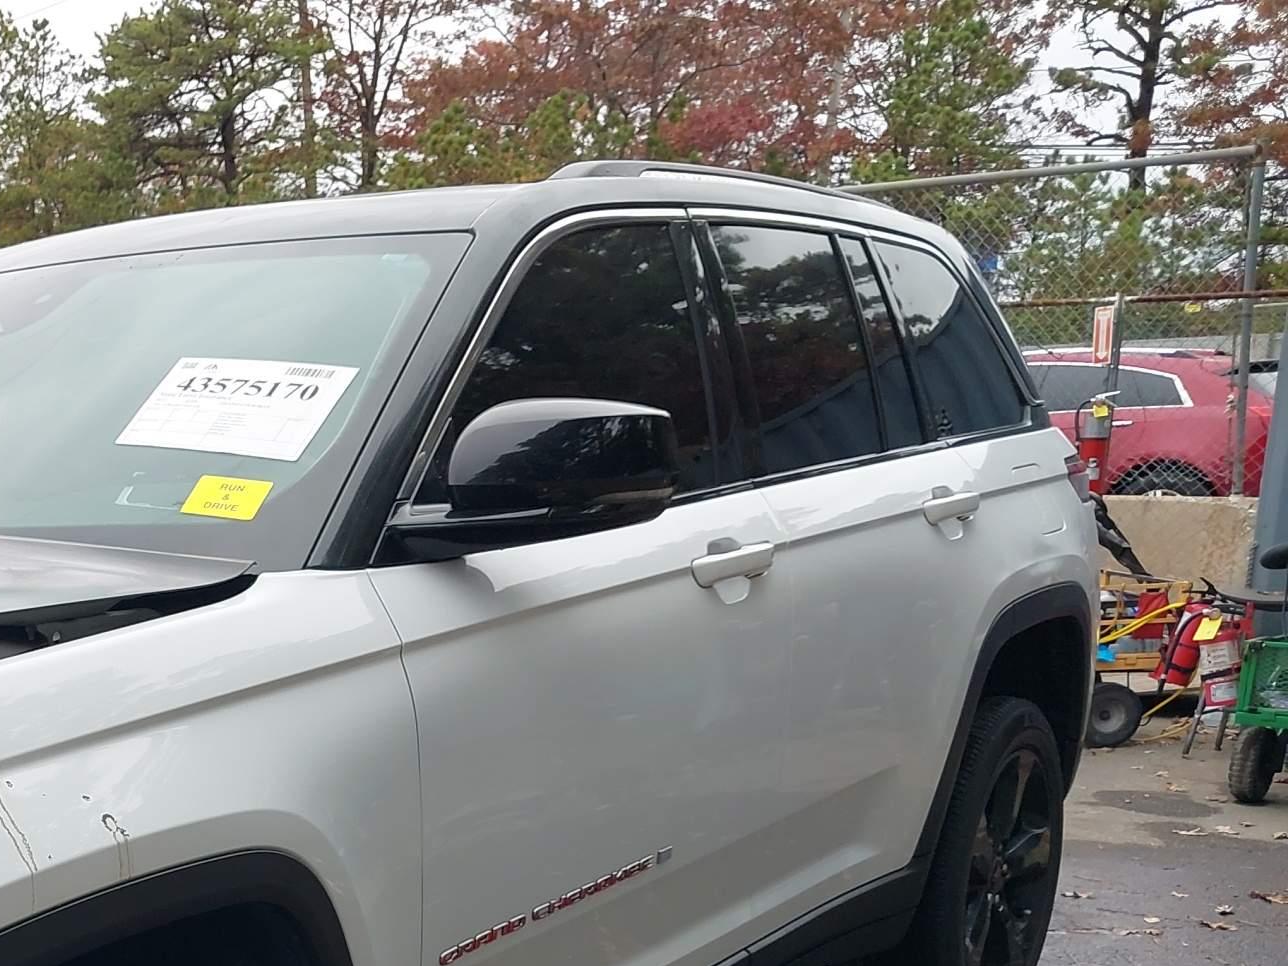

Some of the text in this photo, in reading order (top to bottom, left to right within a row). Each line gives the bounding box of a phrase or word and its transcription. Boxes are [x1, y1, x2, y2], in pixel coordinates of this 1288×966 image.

[176, 376, 319, 401] 43575170
[219, 483, 246, 492] RUN
[222, 493, 230, 501] &
[203, 501, 239, 512] DRIVE
[439, 854, 654, 966] GRAND CHEROKEE
